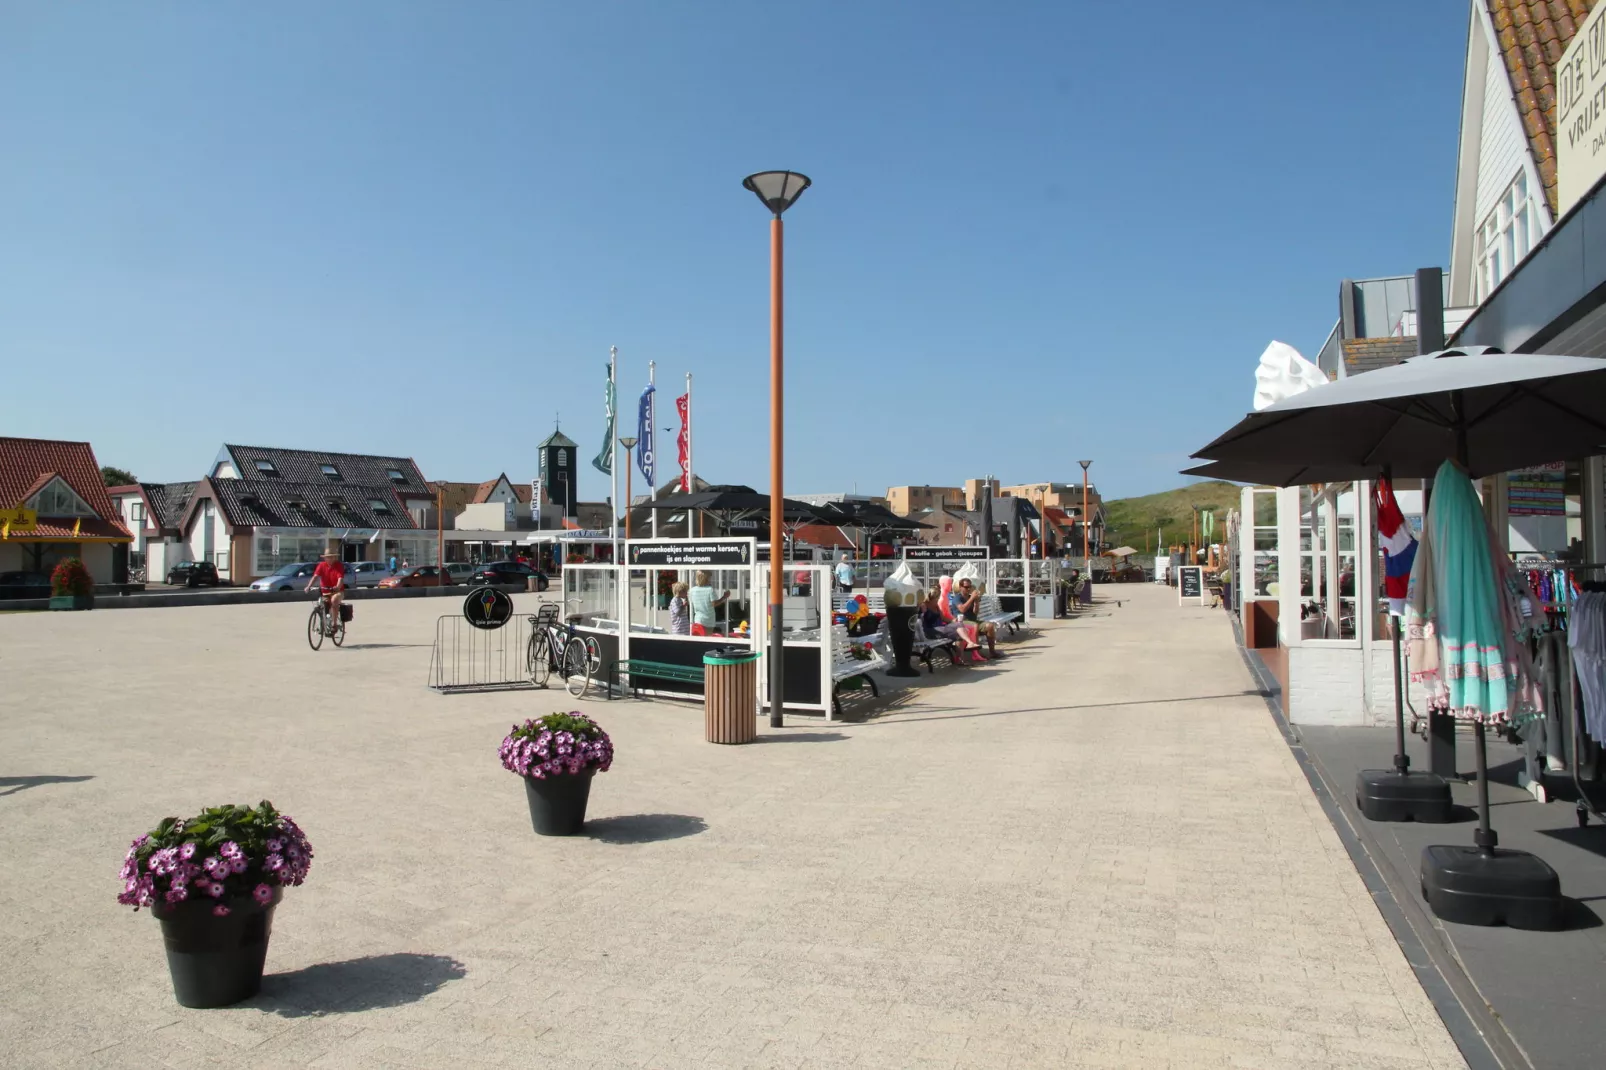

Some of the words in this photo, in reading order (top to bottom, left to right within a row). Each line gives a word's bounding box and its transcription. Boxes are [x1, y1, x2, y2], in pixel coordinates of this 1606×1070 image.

[1560, 39, 1584, 124] DE
[640, 545, 682, 554] pannenkoekjes
[683, 555, 711, 563] slagroom
